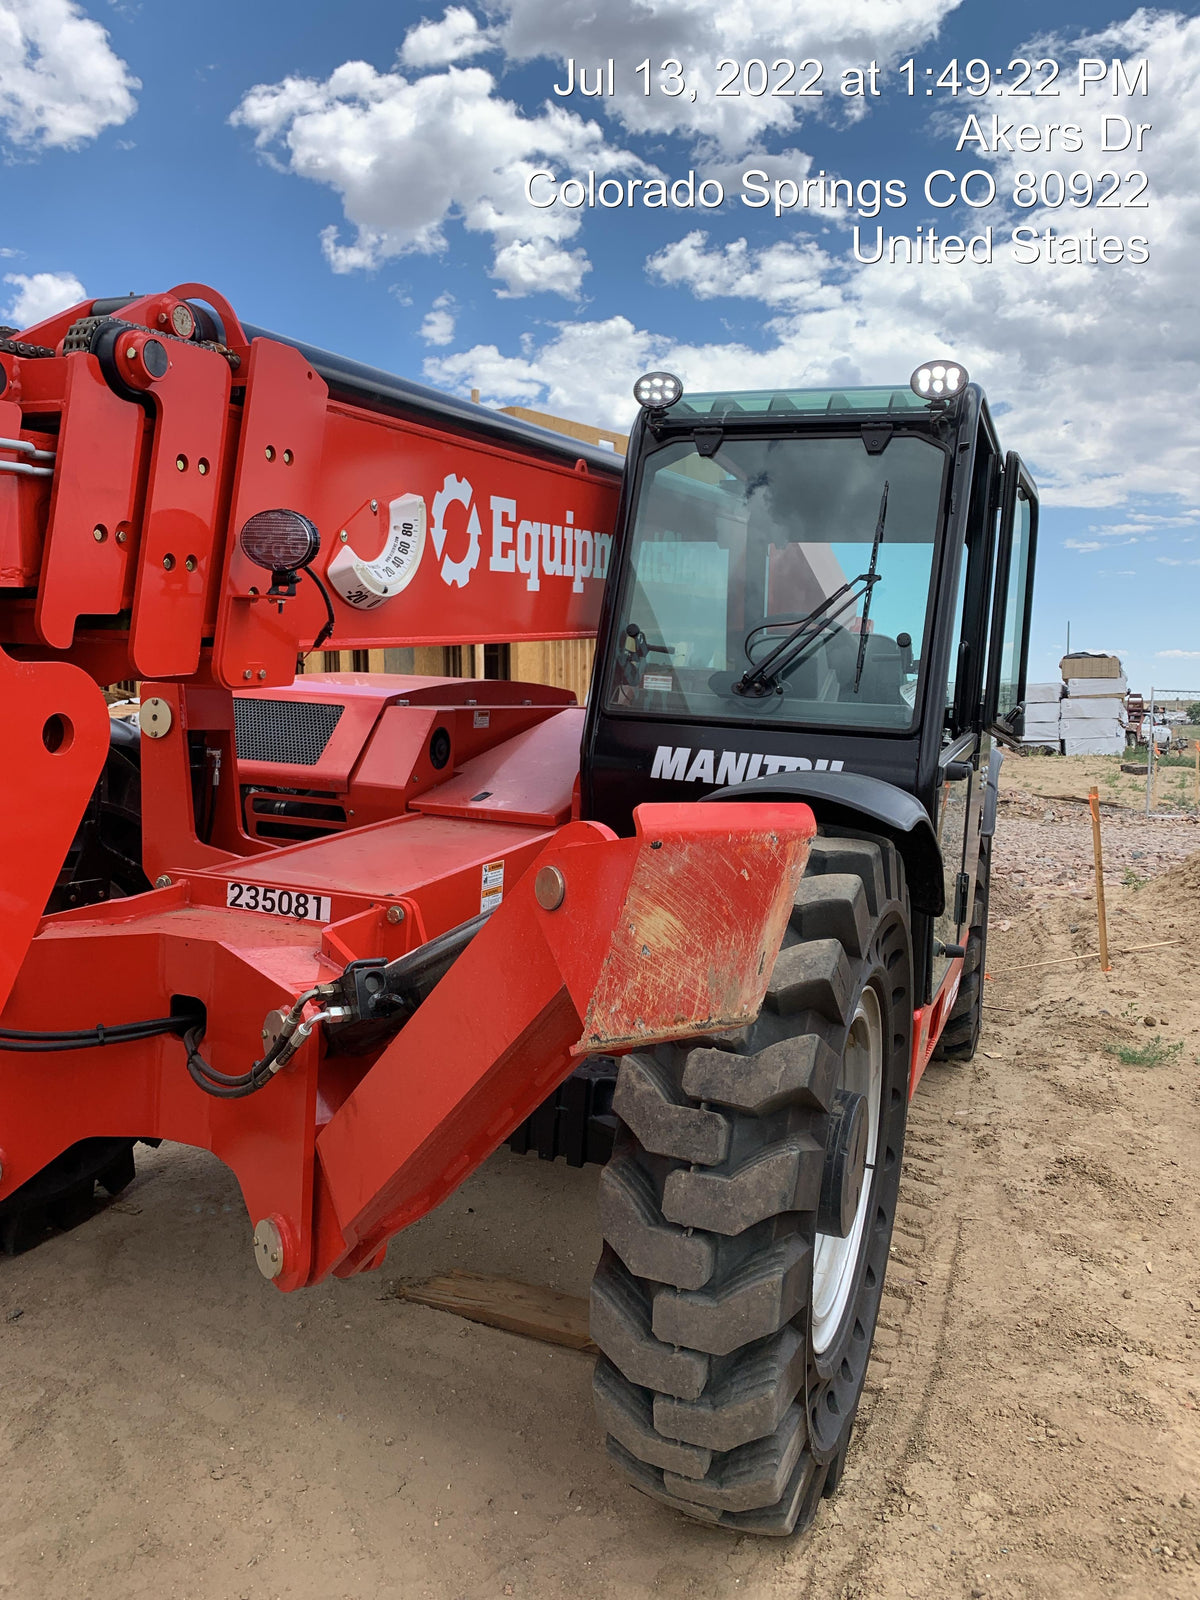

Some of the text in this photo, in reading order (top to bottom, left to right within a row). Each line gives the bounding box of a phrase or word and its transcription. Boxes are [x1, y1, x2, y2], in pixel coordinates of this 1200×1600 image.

[401, 522, 414, 537] 80
[397, 541, 411, 555] 60
[391, 556, 404, 569] 40
[229, 883, 322, 921] 235081
